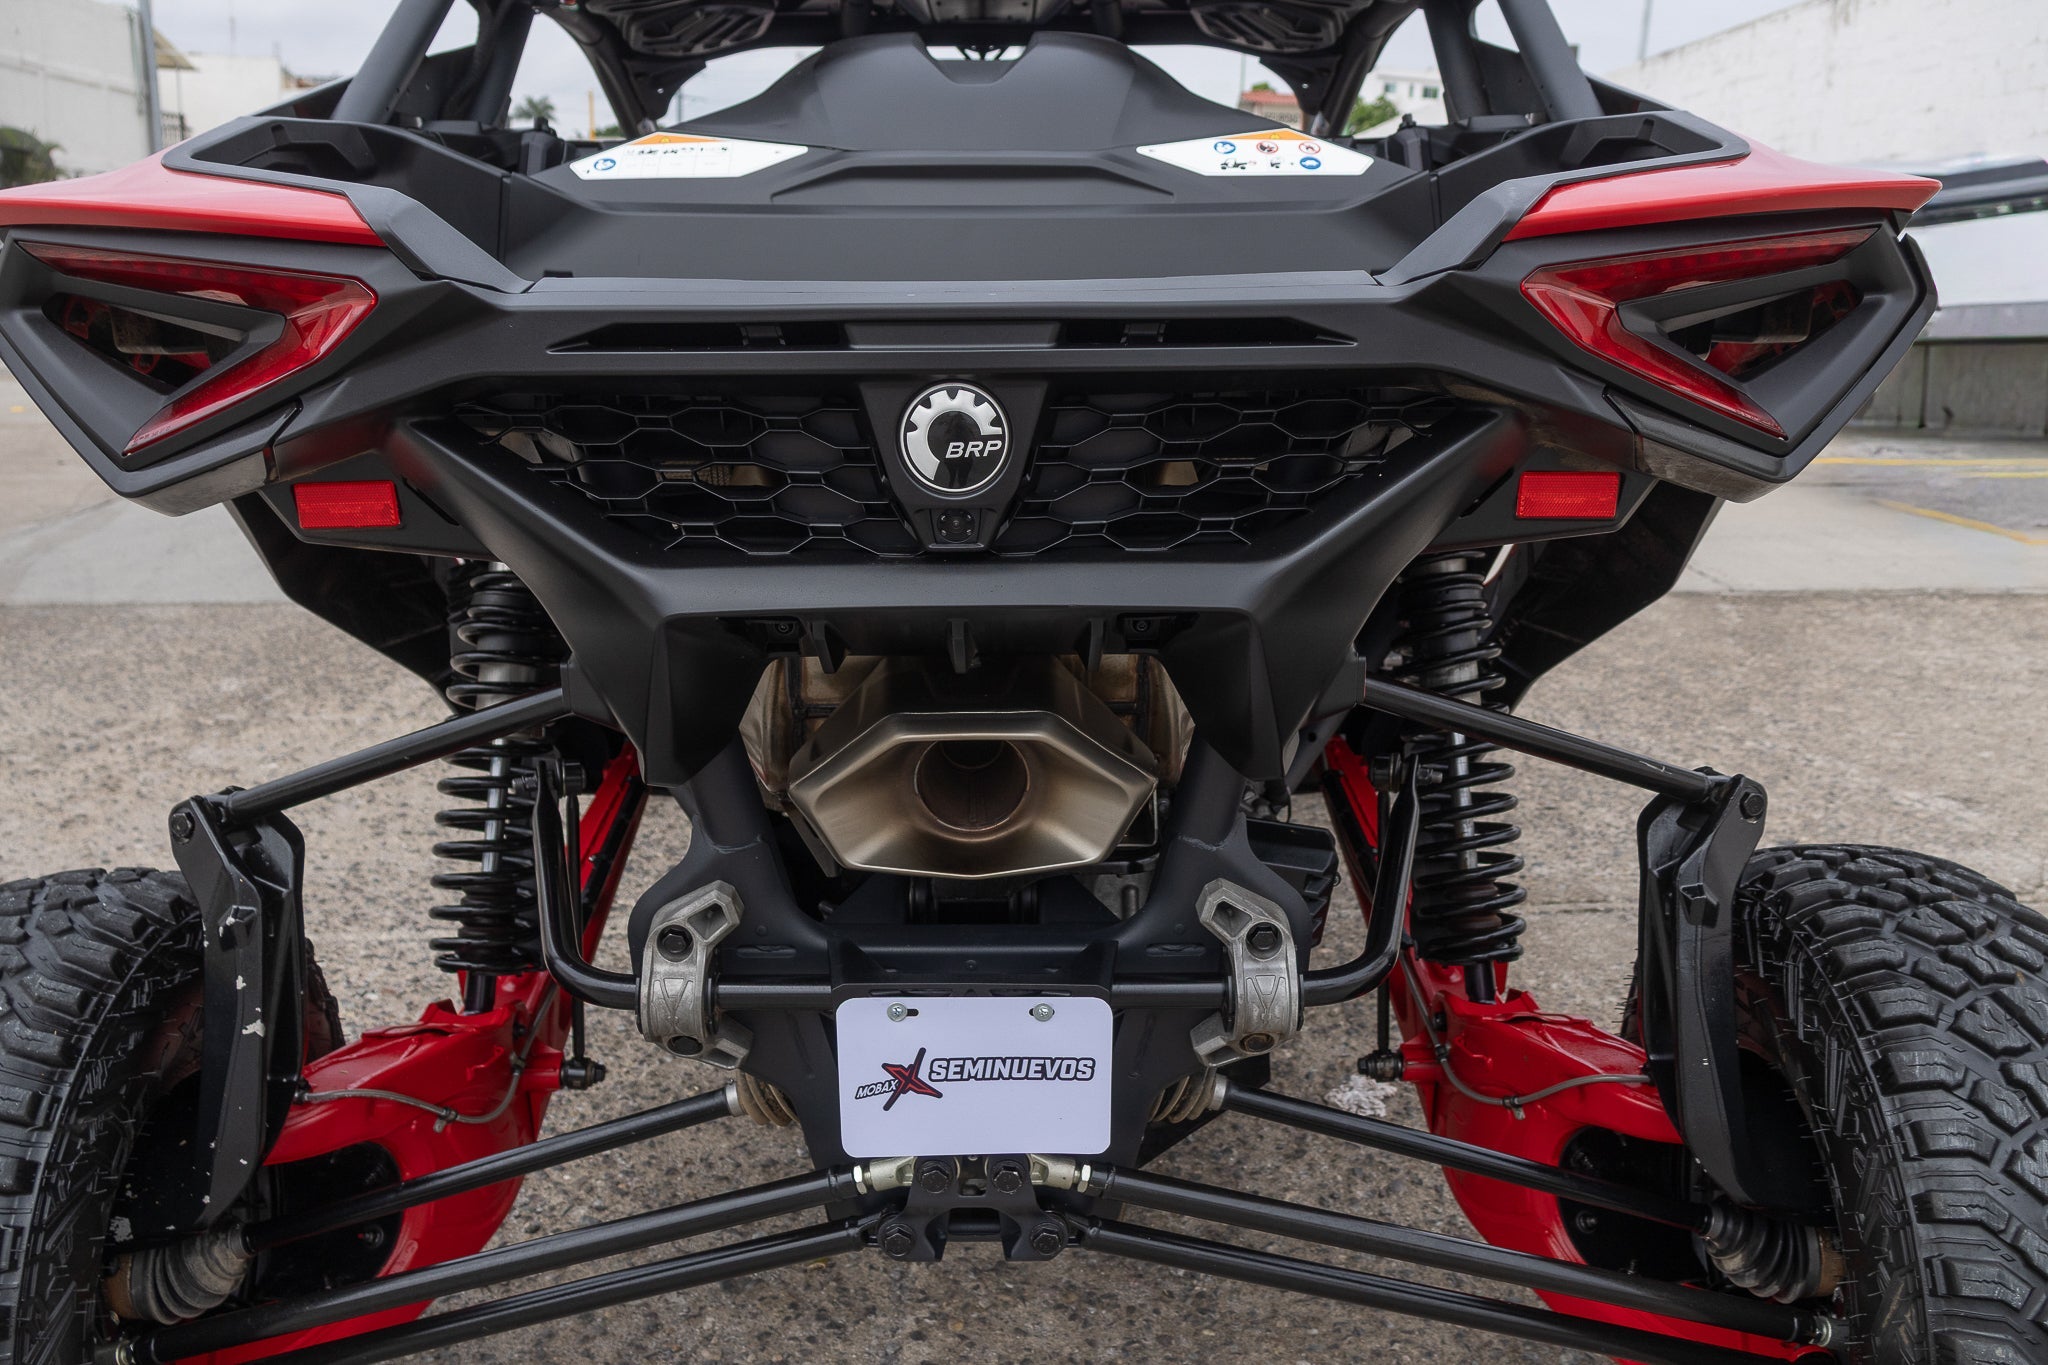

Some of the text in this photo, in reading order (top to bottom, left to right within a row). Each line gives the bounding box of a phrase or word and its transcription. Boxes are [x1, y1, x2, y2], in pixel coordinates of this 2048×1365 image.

[945, 440, 1002, 459] BRP
[855, 1079, 899, 1099] MOBAX
[929, 1057, 1096, 1081] SEMINUEVOS
